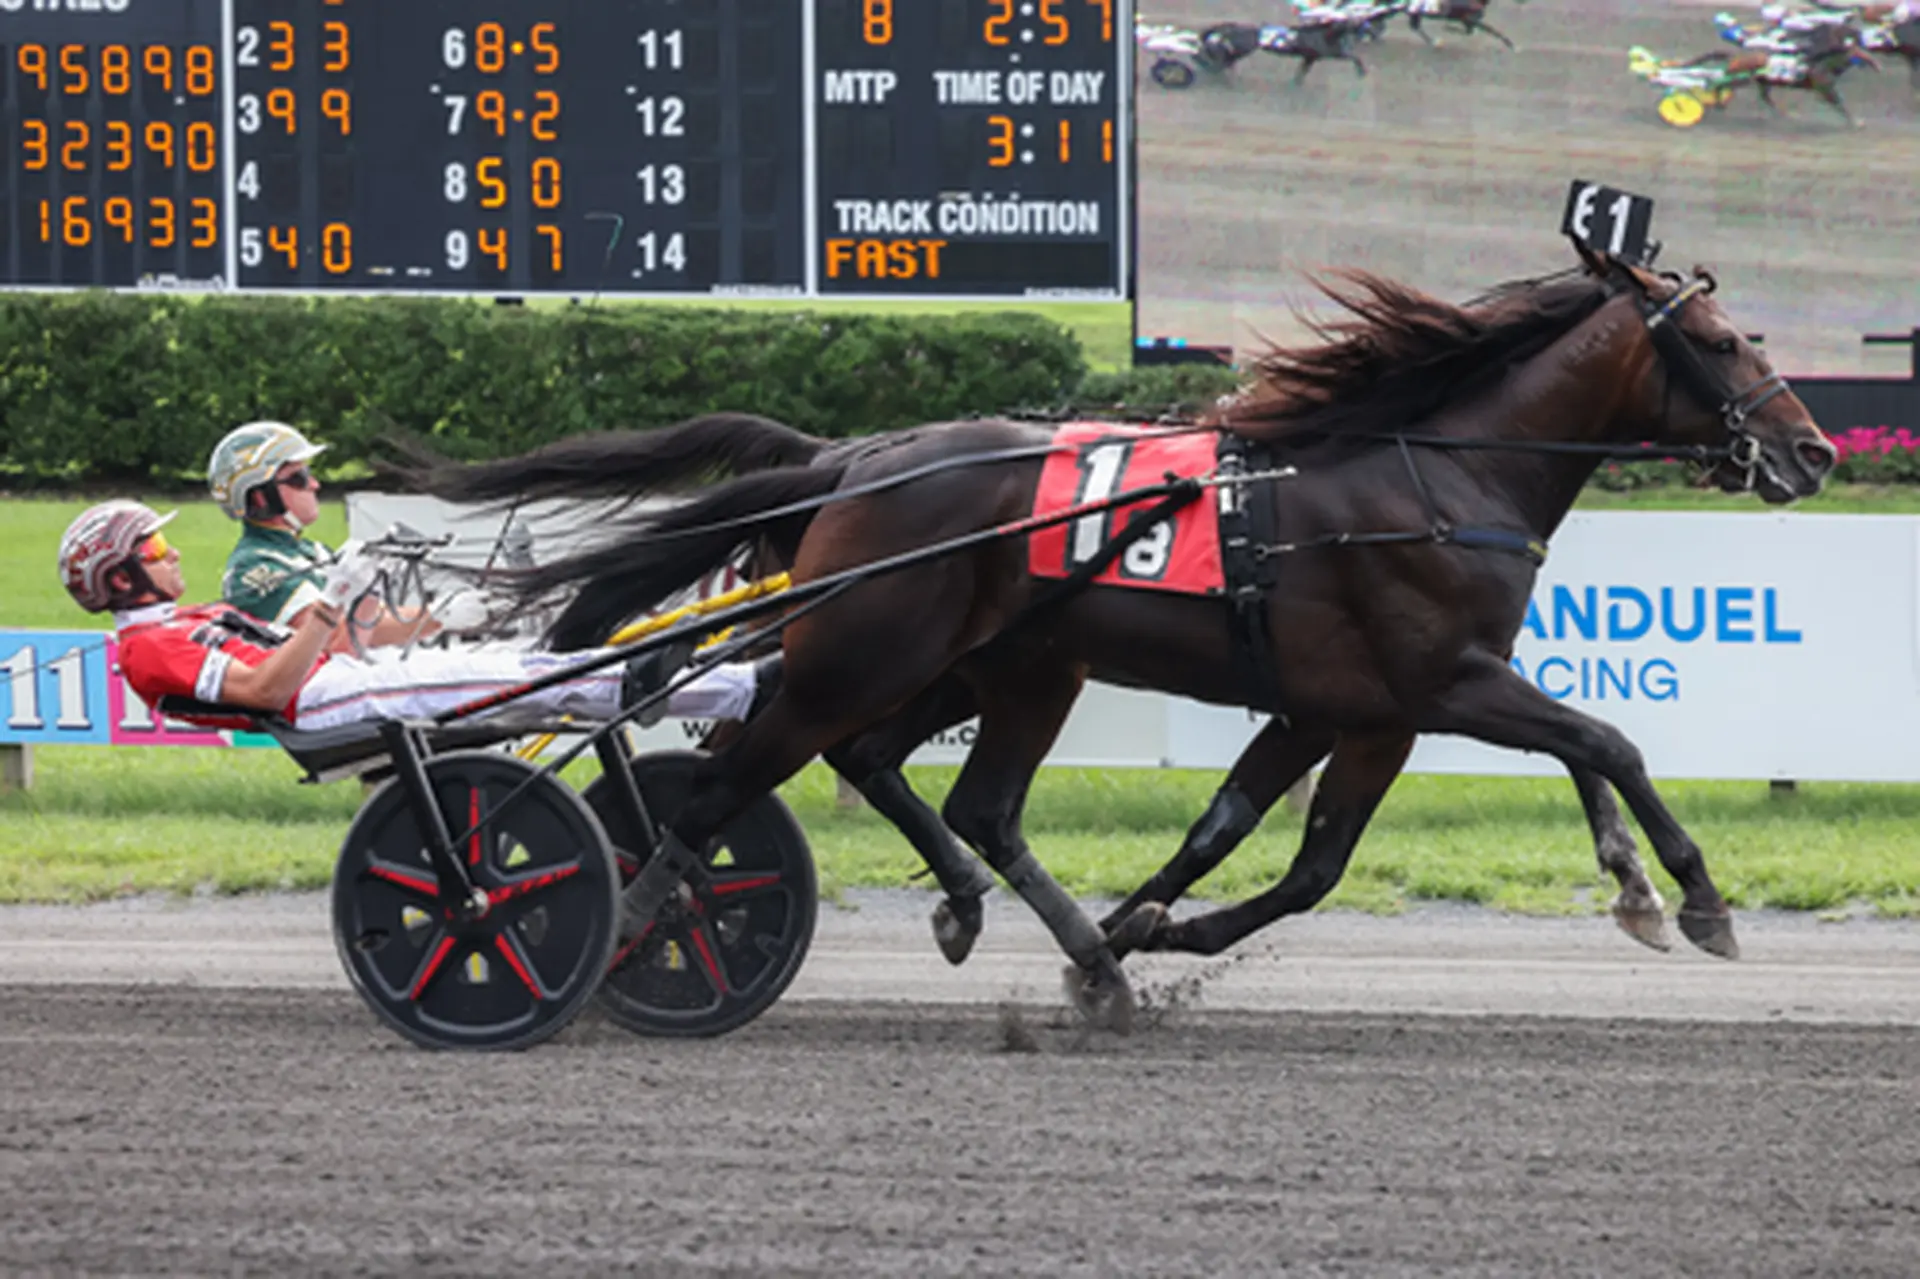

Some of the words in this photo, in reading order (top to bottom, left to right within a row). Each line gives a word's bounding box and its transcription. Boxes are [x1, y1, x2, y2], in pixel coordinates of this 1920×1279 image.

[864, 0, 892, 44] 8
[238, 27, 258, 65] 2
[444, 29, 465, 67] 6
[640, 30, 681, 68] 11
[18, 44, 214, 95] 95898
[825, 71, 896, 102] MTP
[934, 72, 1000, 103] TIME
[1008, 71, 1043, 103] OF
[1051, 72, 1104, 103] DAY
[239, 95, 260, 132] 3
[445, 96, 466, 133] 7
[638, 97, 683, 135] 12
[24, 120, 215, 171] 32390
[988, 116, 1112, 166] 3:11
[238, 162, 259, 198] 4
[445, 163, 466, 201] 8
[638, 165, 684, 204] 13
[40, 197, 216, 247] 16933
[835, 201, 931, 233] TRACK
[939, 202, 1098, 234] CONDITION
[241, 229, 261, 265] 5
[447, 231, 467, 269] 9
[639, 233, 685, 271] 14
[826, 239, 947, 278] FAST
[1523, 585, 1803, 643] ANDUEL
[1510, 656, 1680, 701] CING
